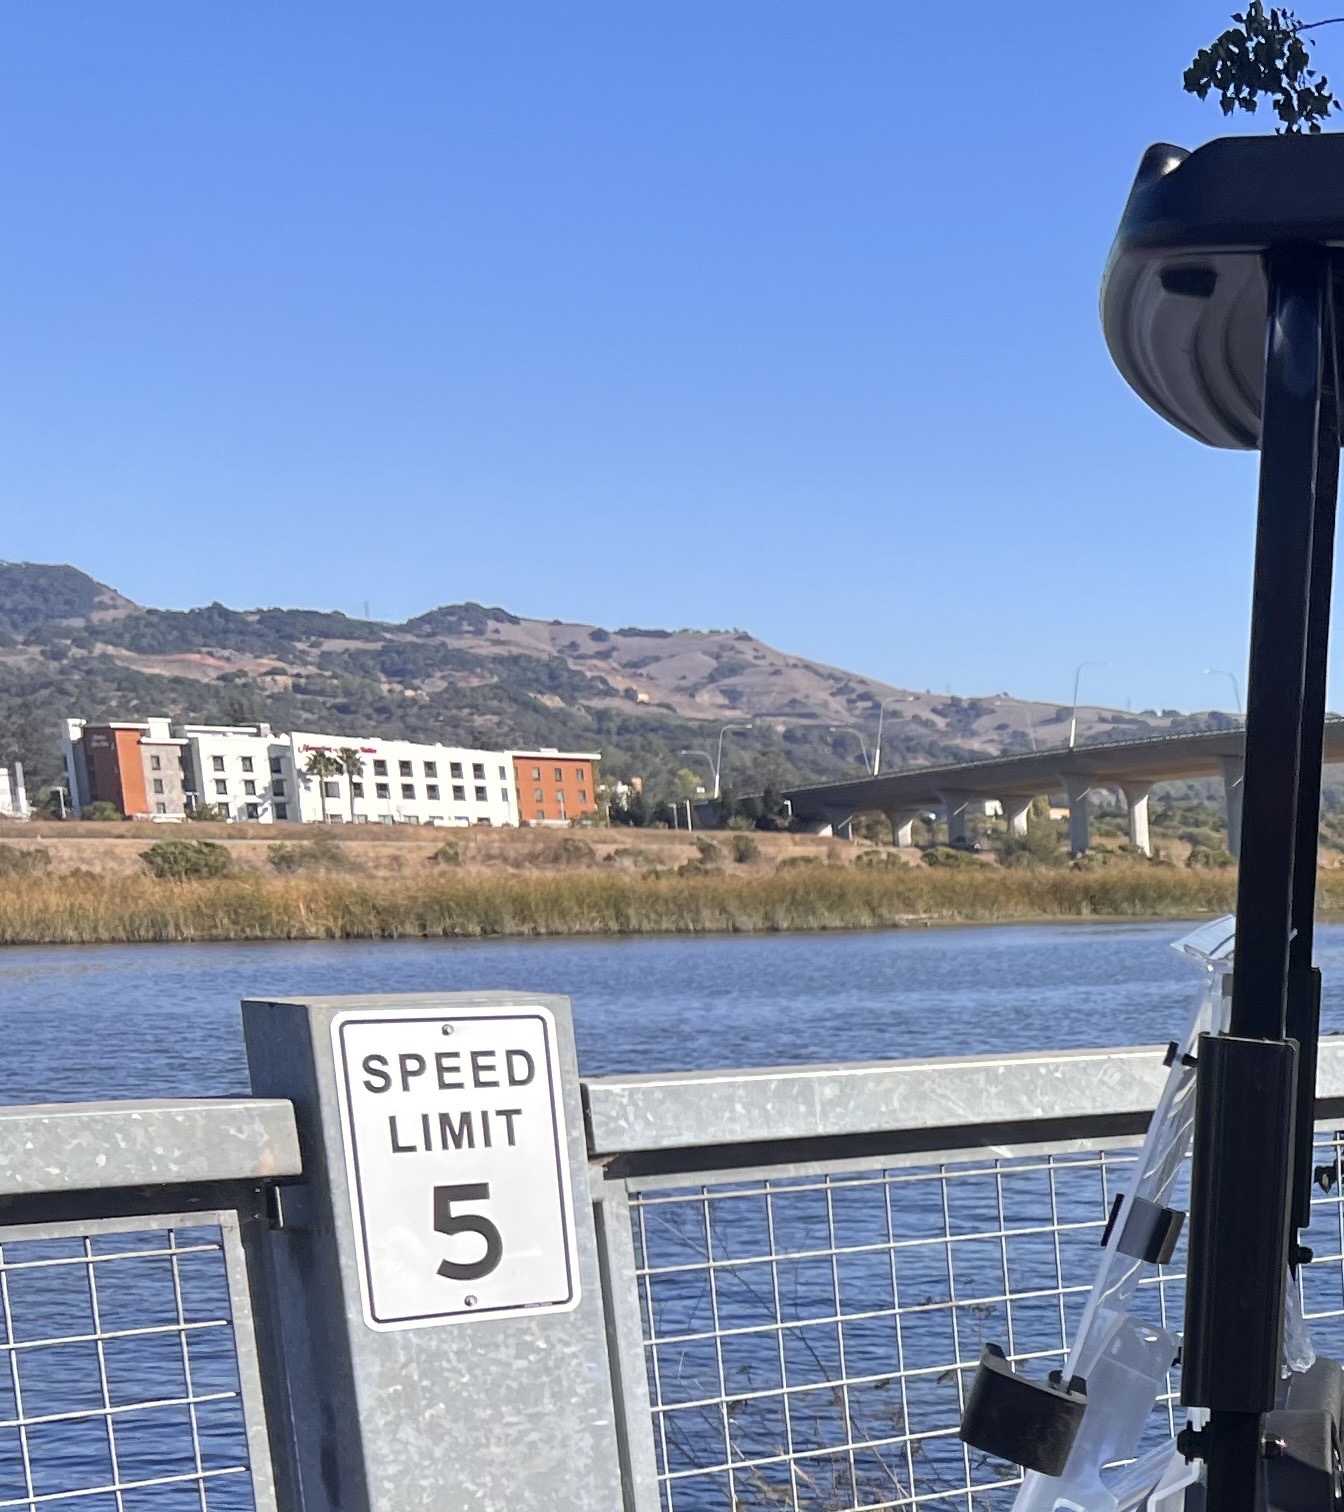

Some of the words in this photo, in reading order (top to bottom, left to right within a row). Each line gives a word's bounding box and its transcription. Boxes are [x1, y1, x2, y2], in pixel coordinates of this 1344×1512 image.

[362, 1048, 536, 1094] SPEED
[388, 1108, 523, 1154] LIMIT
[433, 1182, 503, 1281] 5
